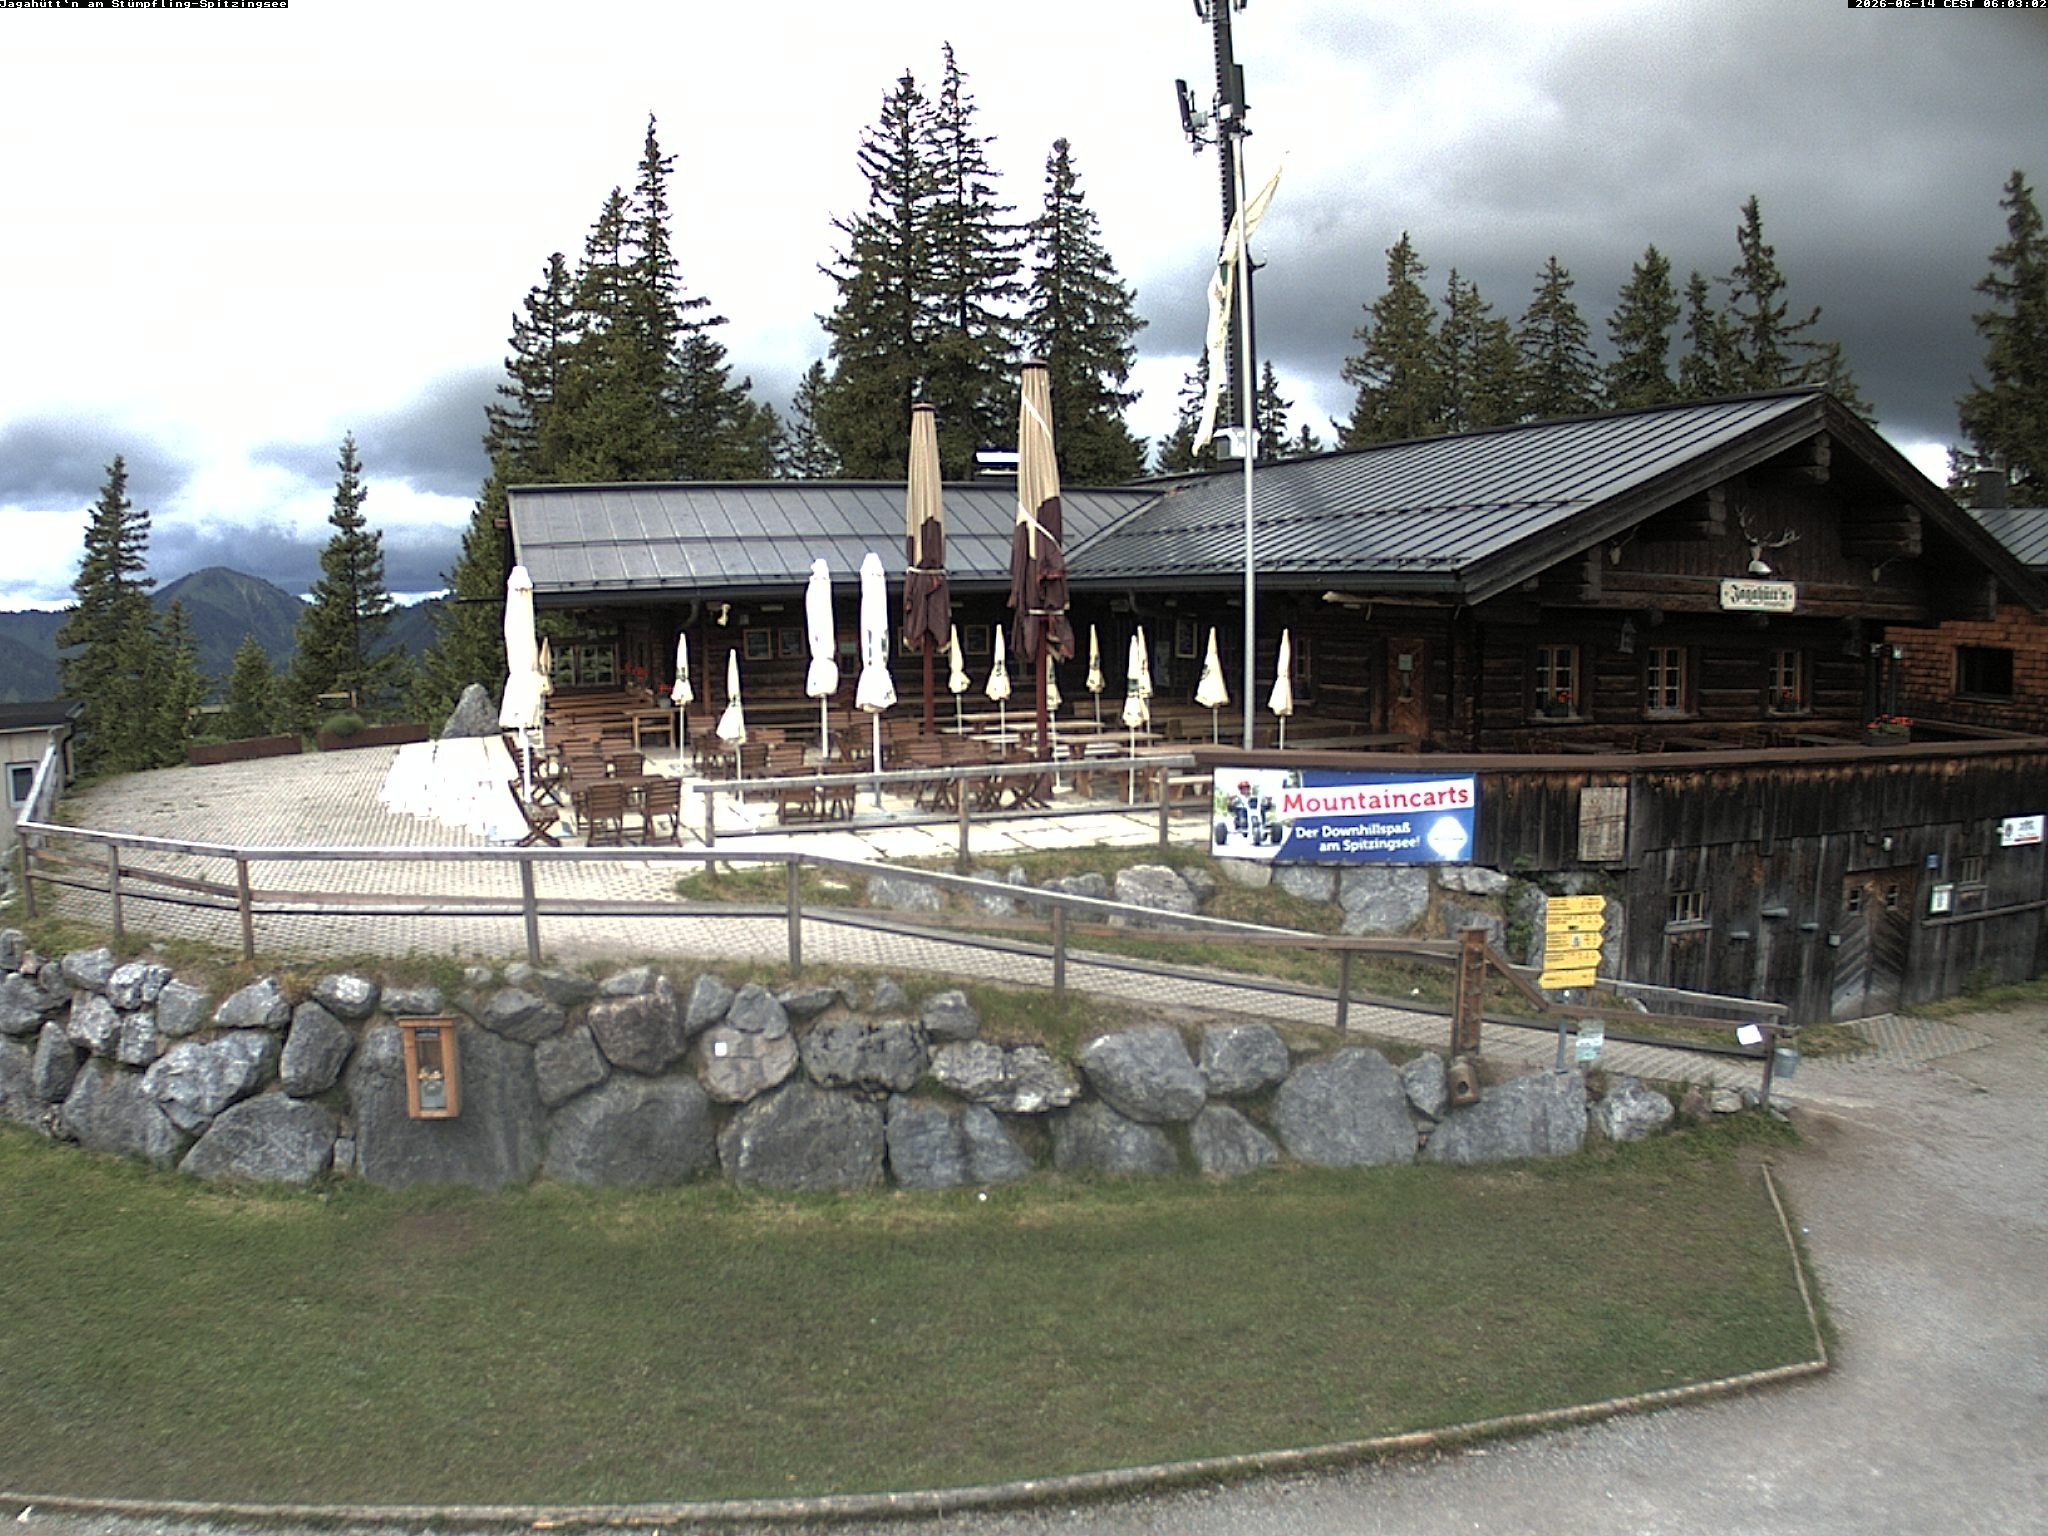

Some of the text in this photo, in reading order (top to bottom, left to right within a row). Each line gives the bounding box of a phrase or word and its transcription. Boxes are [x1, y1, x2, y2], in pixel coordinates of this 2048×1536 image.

[1282, 786, 1470, 813] Mountaincarts
[1295, 821, 1412, 839] Der Downhillspaß
[1319, 835, 1421, 854] am Spitzingsee!
